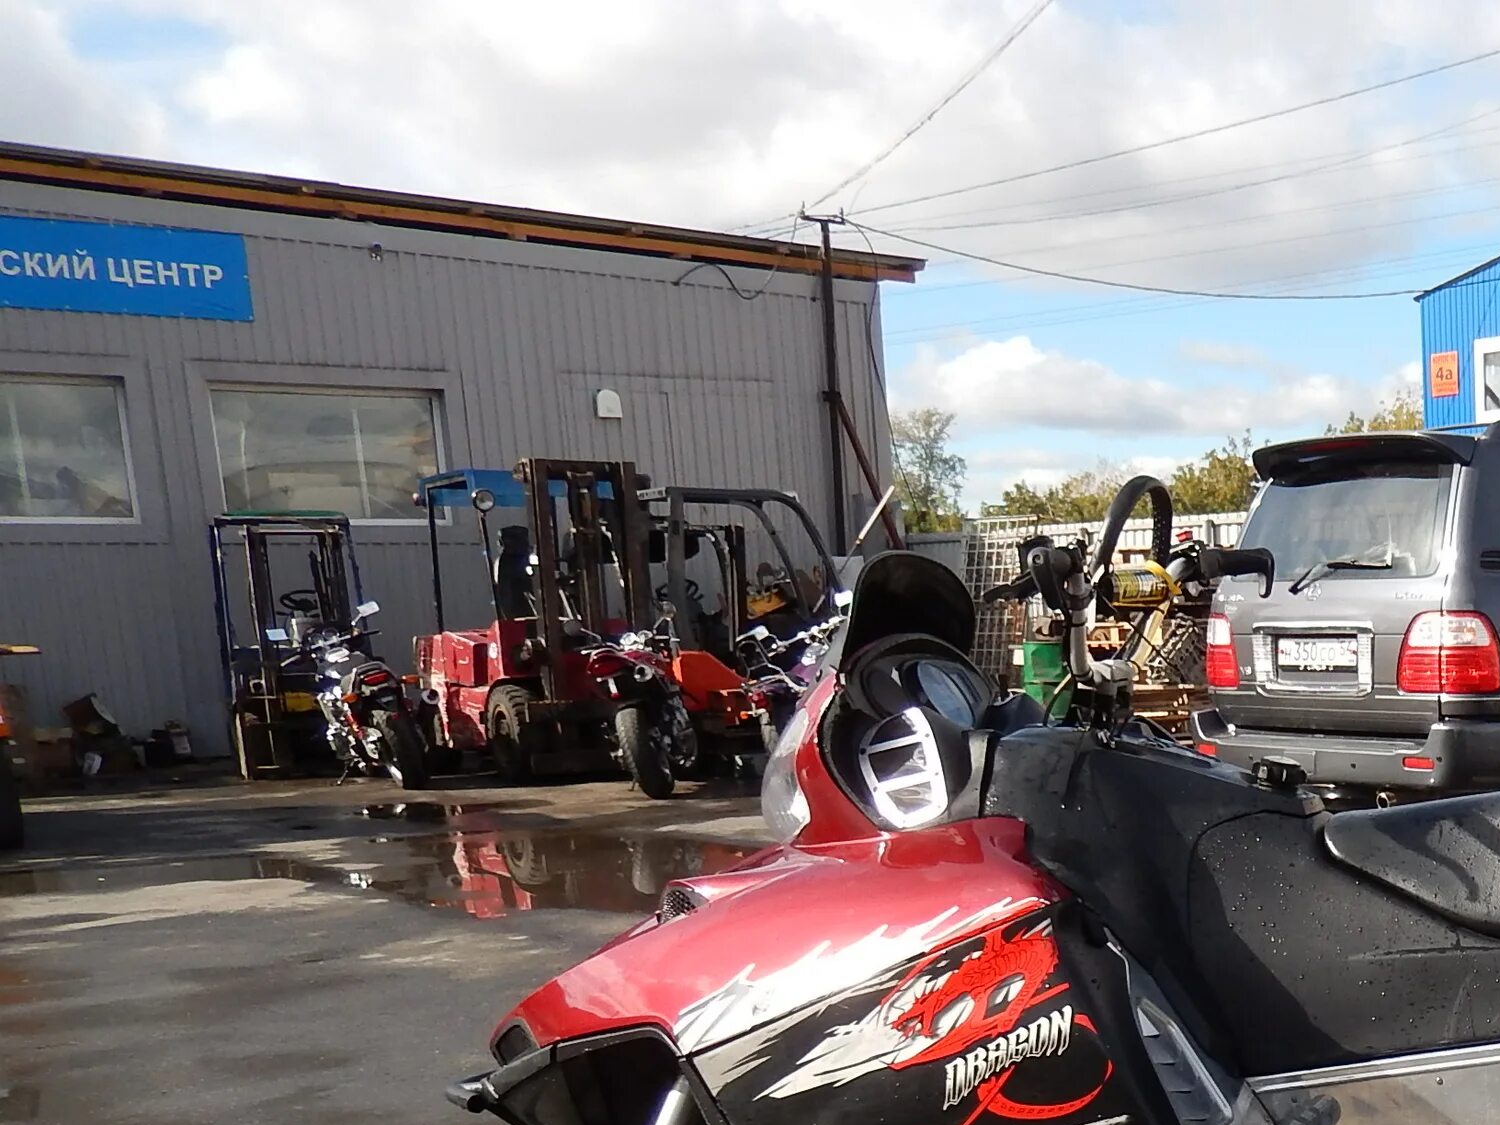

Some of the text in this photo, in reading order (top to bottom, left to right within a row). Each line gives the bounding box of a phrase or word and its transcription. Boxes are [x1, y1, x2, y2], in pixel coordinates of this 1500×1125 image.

[0, 248, 224, 289] СКИЙ ЦЕНТР
[942, 1004, 1073, 1111] DRAGON
